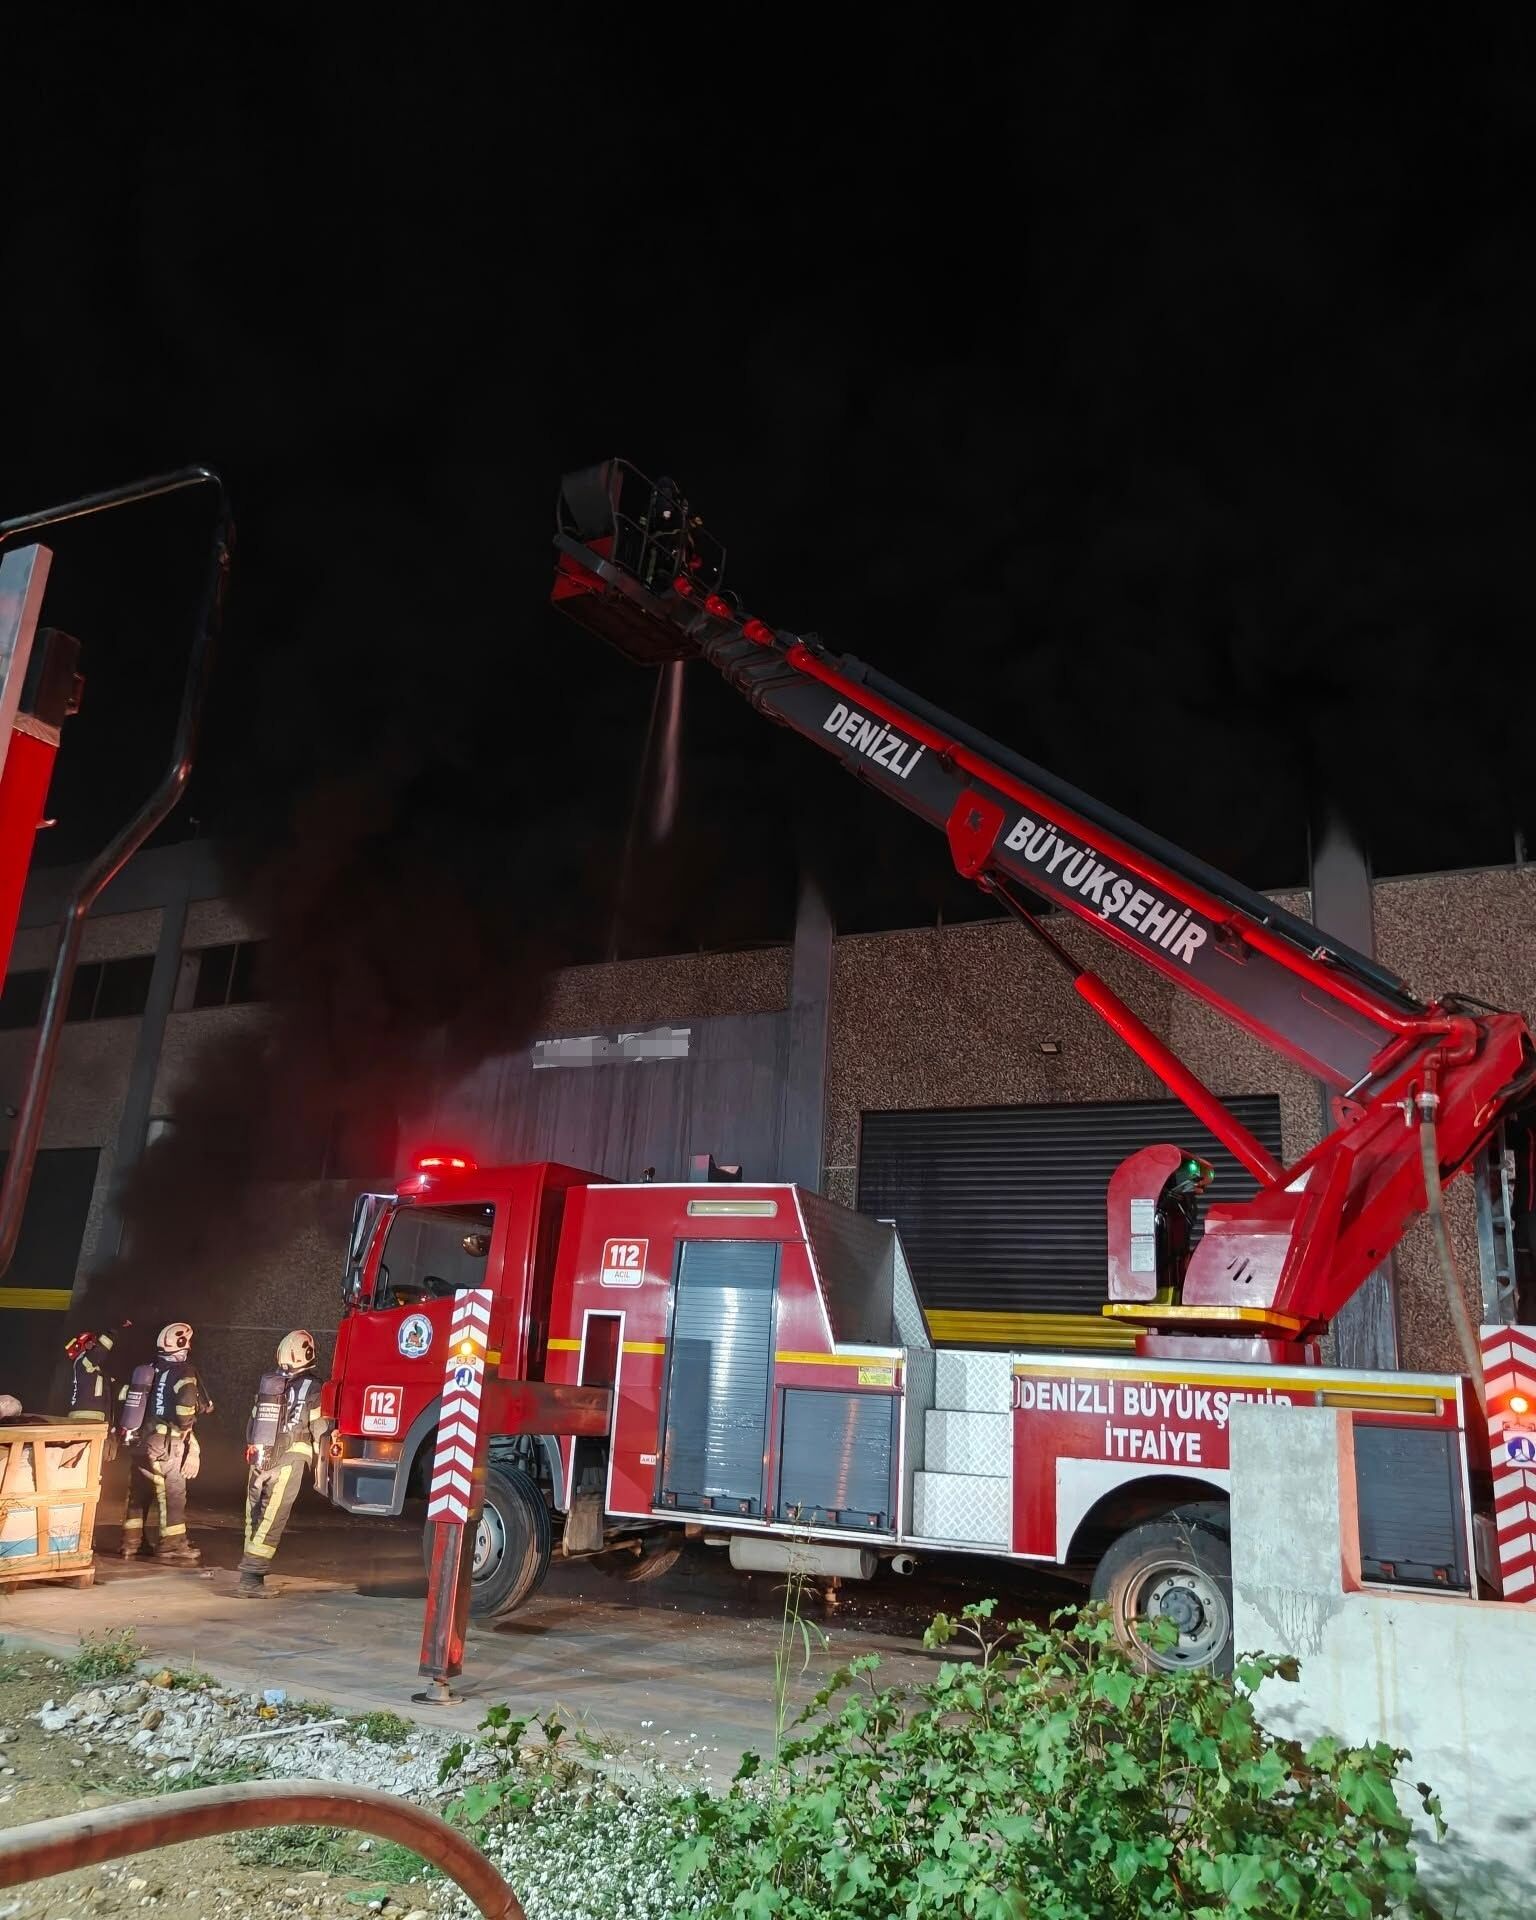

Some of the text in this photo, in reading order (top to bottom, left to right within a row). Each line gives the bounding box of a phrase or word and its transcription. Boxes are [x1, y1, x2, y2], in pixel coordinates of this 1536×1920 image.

[823, 703, 1208, 965] DENİZLİ BÜYÜKŞEHİR
[610, 1244, 640, 1267] 112
[370, 1391, 395, 1415] 112
[1020, 1376, 1292, 1429] DENİZLİ BÜYÜKŞ
[1105, 1420, 1202, 1462] İTFAİYE
